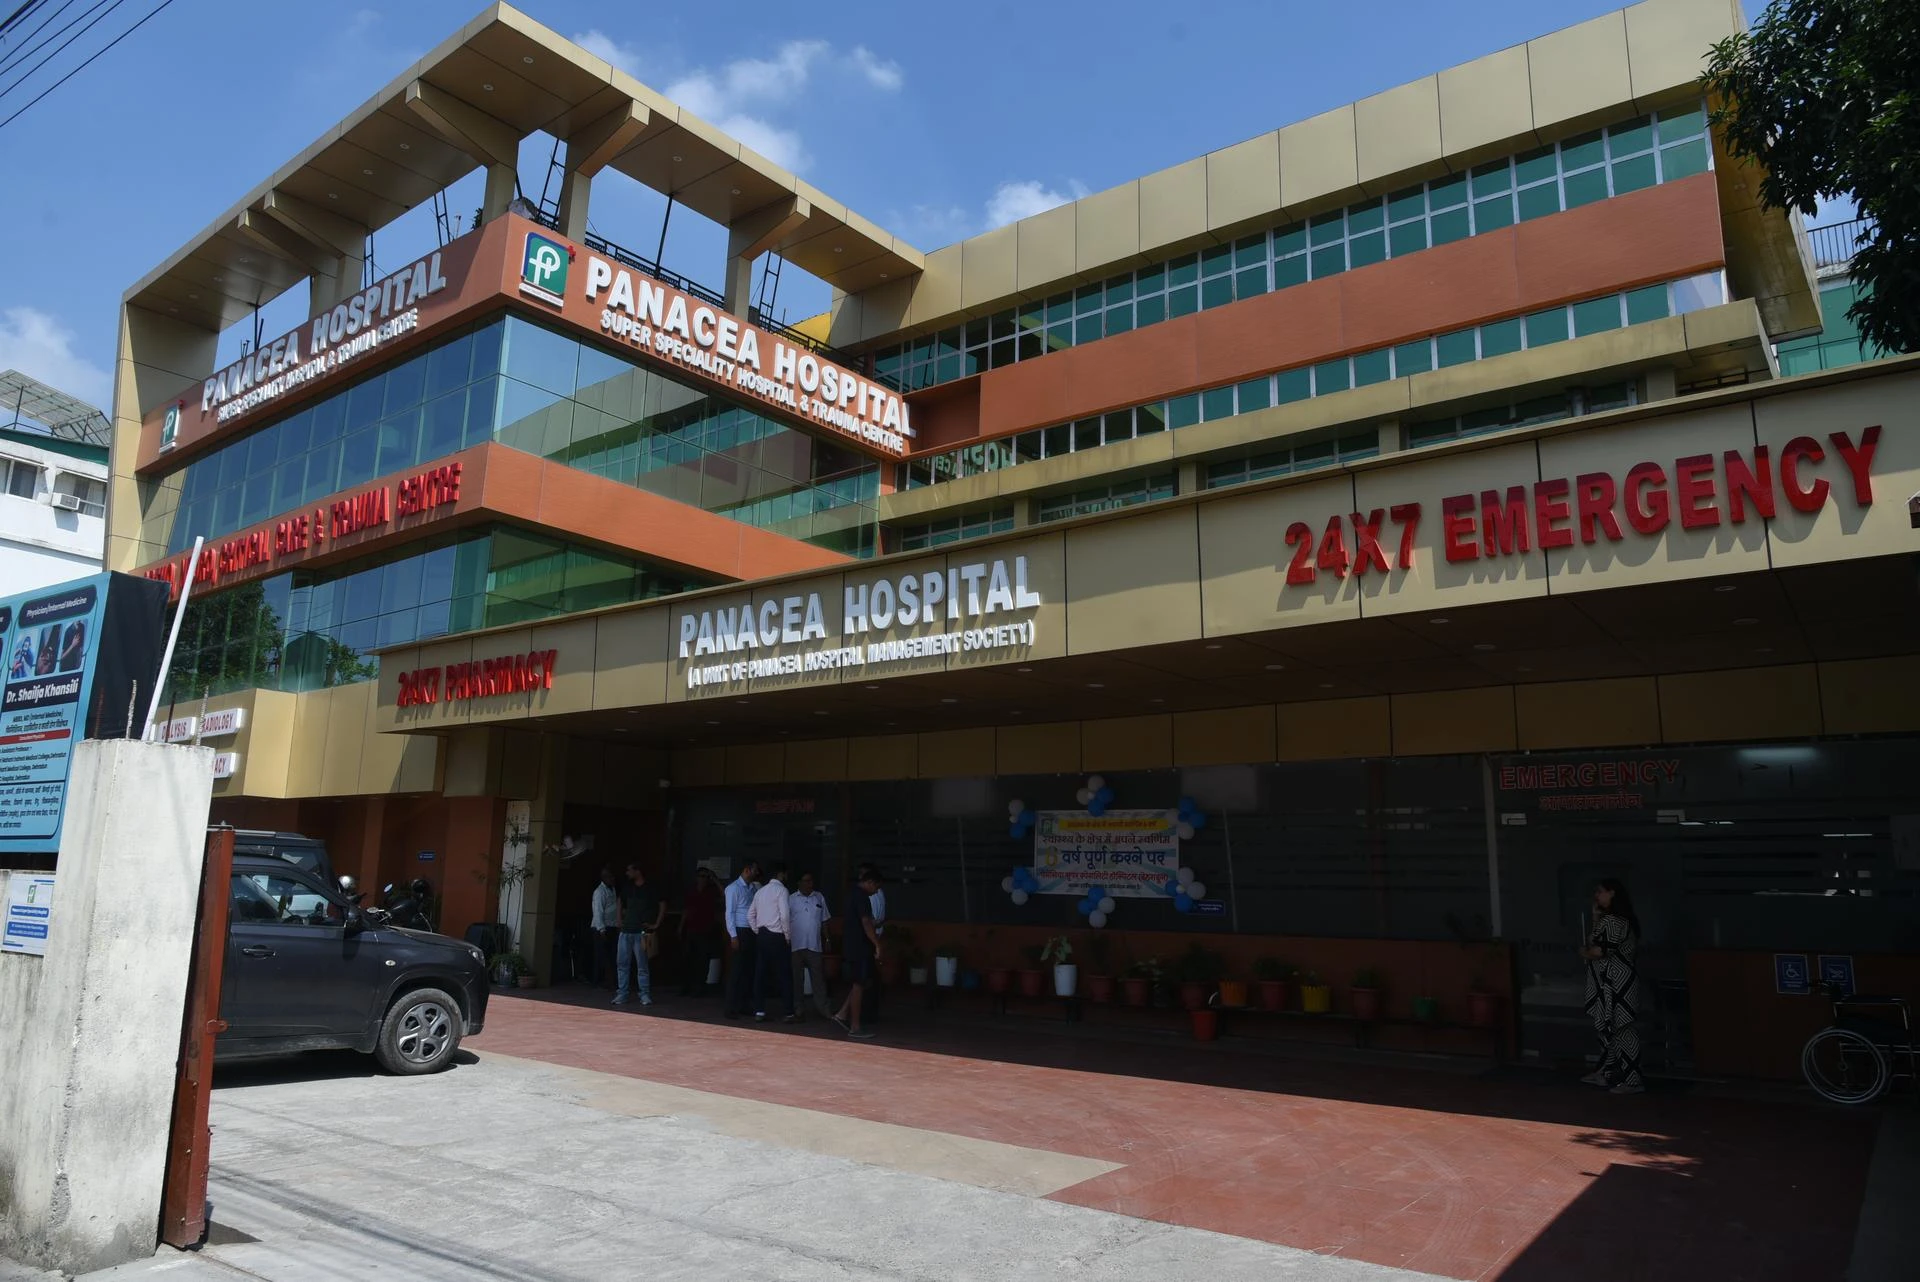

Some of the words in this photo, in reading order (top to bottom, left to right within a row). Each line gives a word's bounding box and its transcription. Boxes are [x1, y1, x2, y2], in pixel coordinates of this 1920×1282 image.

[201, 331, 299, 412] PANACEA
[310, 252, 447, 355] HOSPITAL
[326, 350, 336, 369] &
[337, 329, 377, 364] TRAUMA
[377, 307, 418, 342] CENTRE
[585, 256, 760, 370] PANACEA
[773, 342, 917, 438] HOSPITAL
[600, 309, 652, 347] SUPER
[655, 332, 735, 380] SPECIALITY
[737, 367, 797, 408] HOSPITAL
[800, 394, 809, 412] &
[811, 399, 861, 435] TRAUMA
[861, 421, 904, 453] CENTRE
[220, 528, 271, 576] CRITICAL
[275, 514, 309, 558] CARE
[312, 508, 324, 545] &
[330, 486, 390, 539] TRAUMA
[397, 461, 463, 517] CENTRE
[1285, 502, 1422, 587] 24X7
[1442, 425, 1883, 564] EMERGENCY
[66, 596, 87, 608] Medicine
[679, 592, 828, 659] PANACEA
[843, 556, 1041, 635] HOSPITAL
[445, 648, 558, 702] PHARMACY
[687, 666, 702, 689] (A
[702, 663, 729, 686] UNIT
[731, 661, 748, 681] OF
[748, 652, 802, 680] PANACEA
[805, 645, 865, 673] HOSPITAL
[867, 632, 962, 663] MANAGEMENT
[963, 619, 1034, 652] SOCIETY)
[6, 690, 17, 703] Dr.
[18, 685, 44, 703] Shailja
[45, 678, 80, 697] Khansili
[1499, 758, 1681, 791] EMERGENCY
[1043, 836, 1074, 845] स्वास्थ्य
[1076, 833, 1085, 844] के
[1088, 833, 1103, 844] क्षेत्र
[1104, 832, 1113, 844] में
[1114, 833, 1136, 844] अपने
[1061, 845, 1081, 865] वर्ष
[1084, 845, 1110, 870] पूर्ण
[1110, 846, 1144, 865] करने
[1146, 851, 1167, 866] पर
